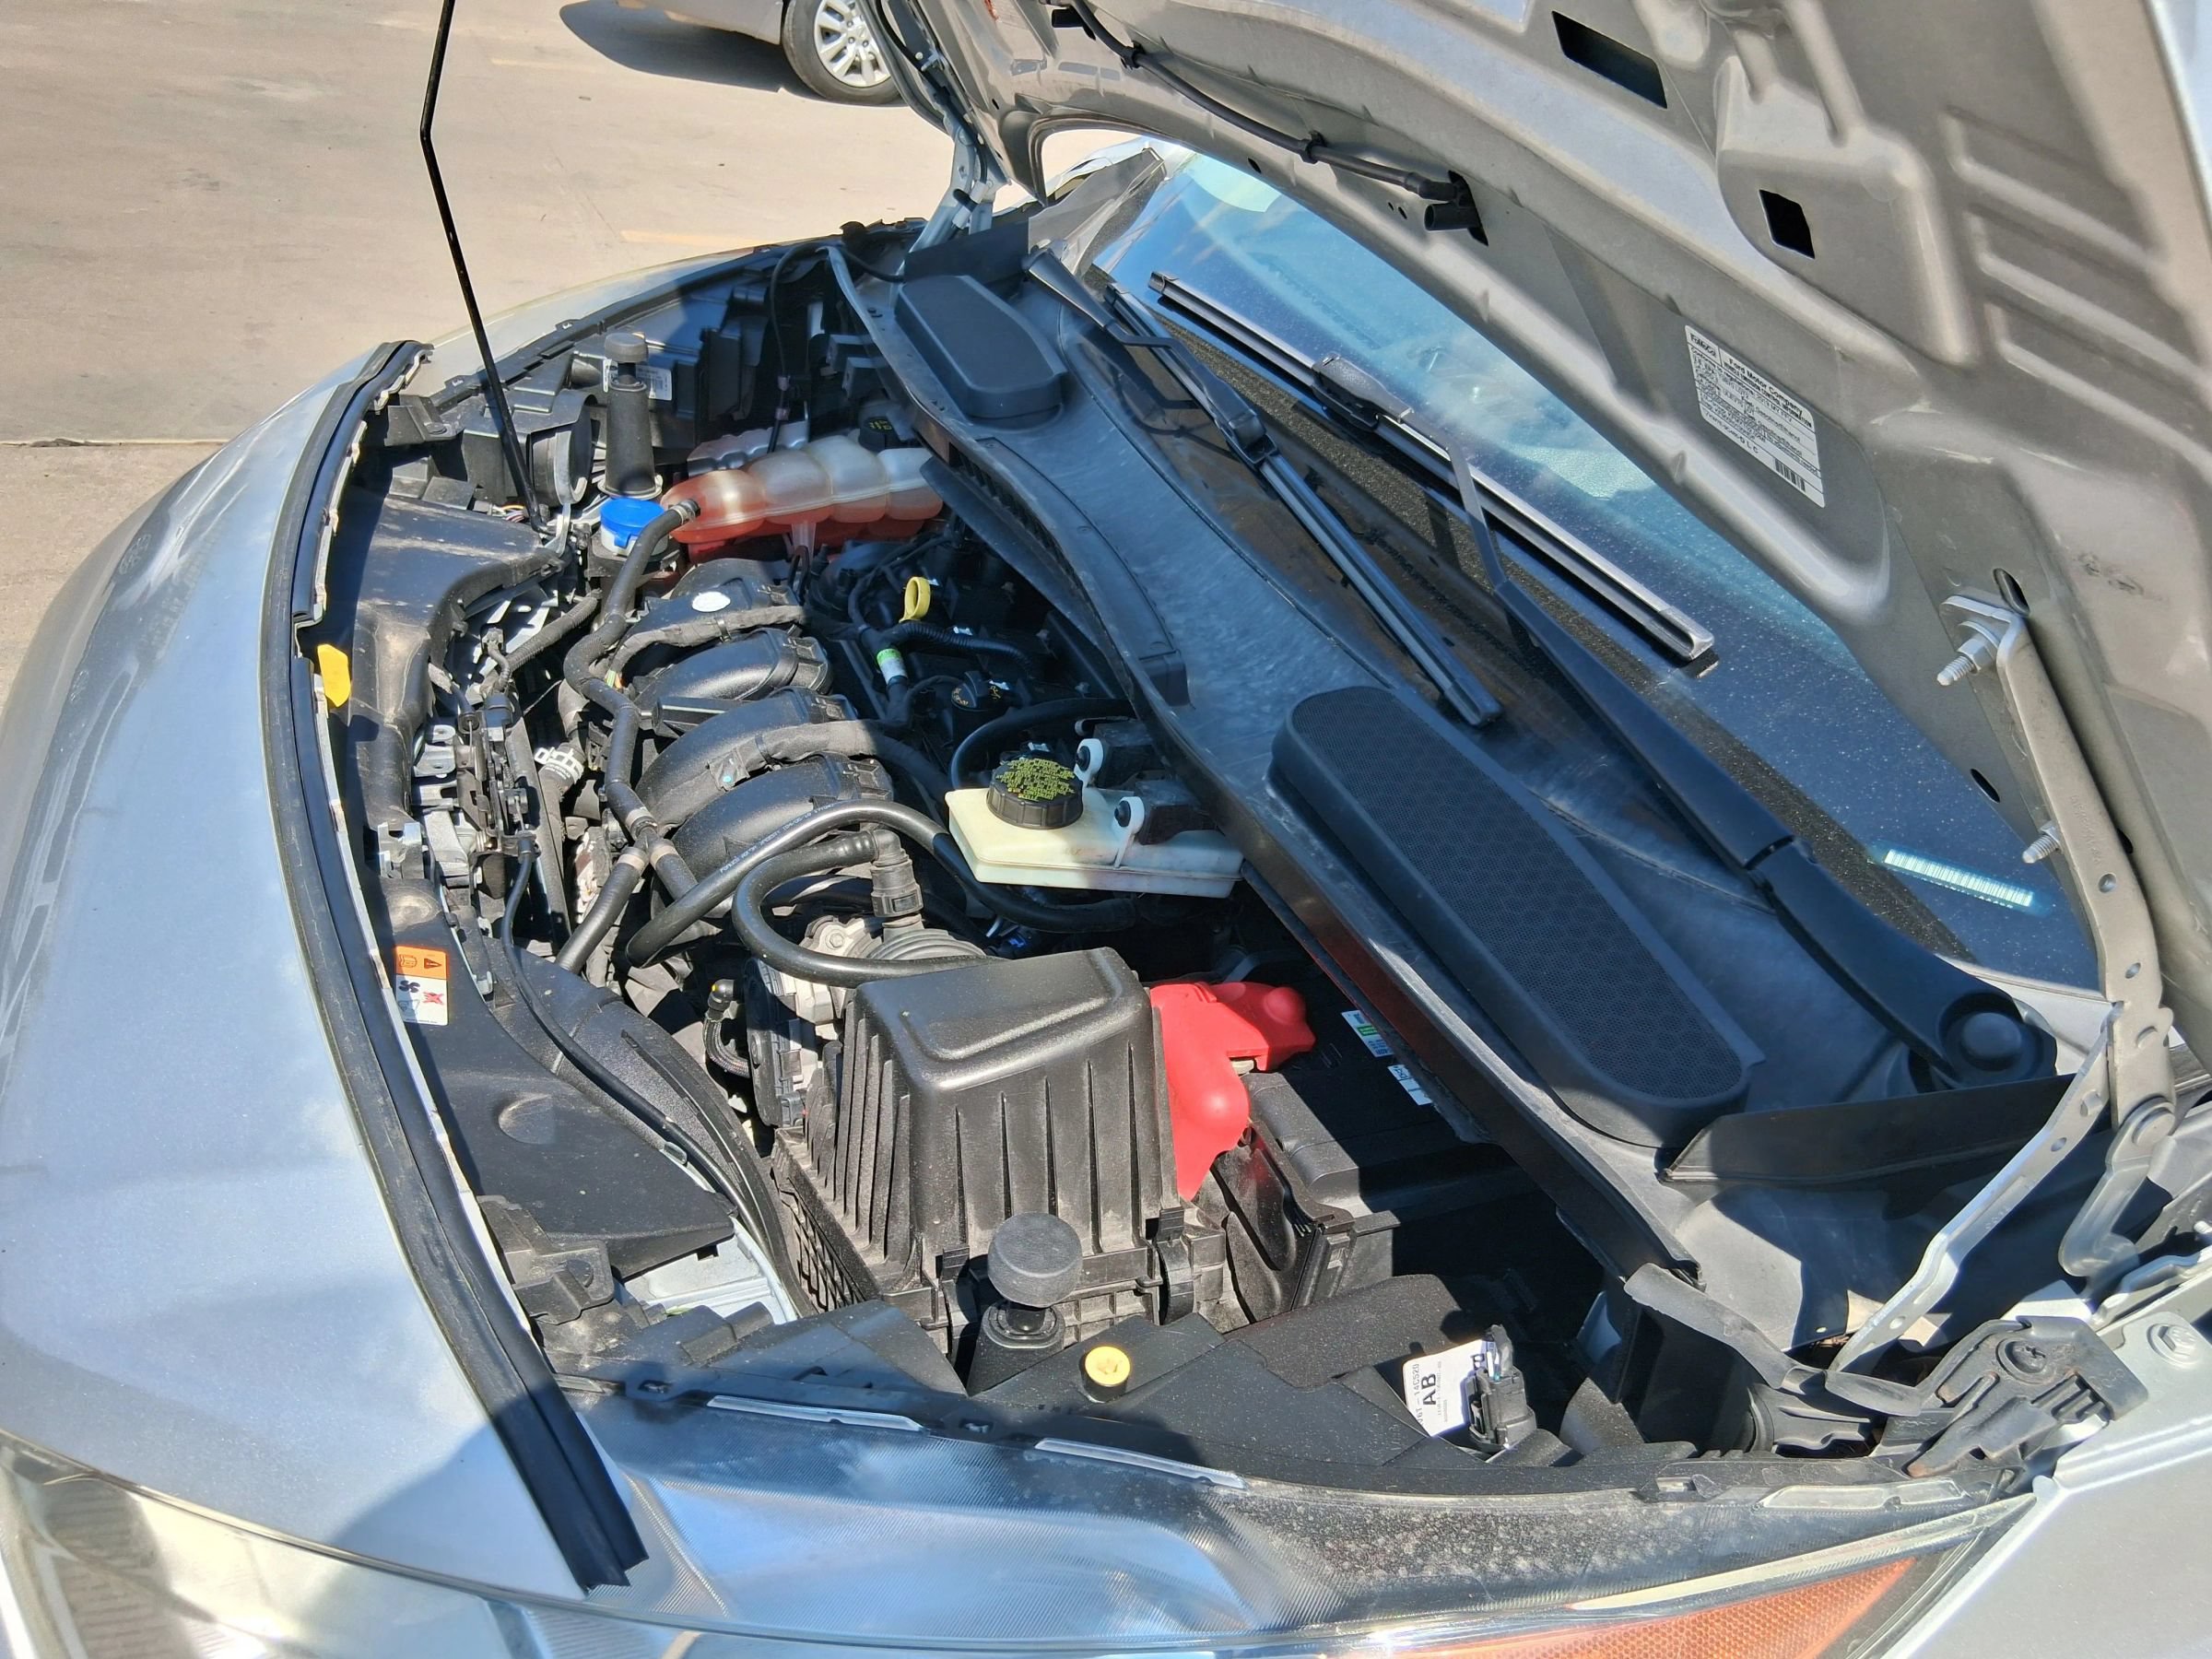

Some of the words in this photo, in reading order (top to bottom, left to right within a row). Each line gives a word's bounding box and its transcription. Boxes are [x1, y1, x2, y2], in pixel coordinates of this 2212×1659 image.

[1729, 359, 1745, 373] Ford
[1747, 370, 1767, 388] Motor
[1769, 386, 1803, 419] Company
[1420, 1373, 1437, 1406] AB
